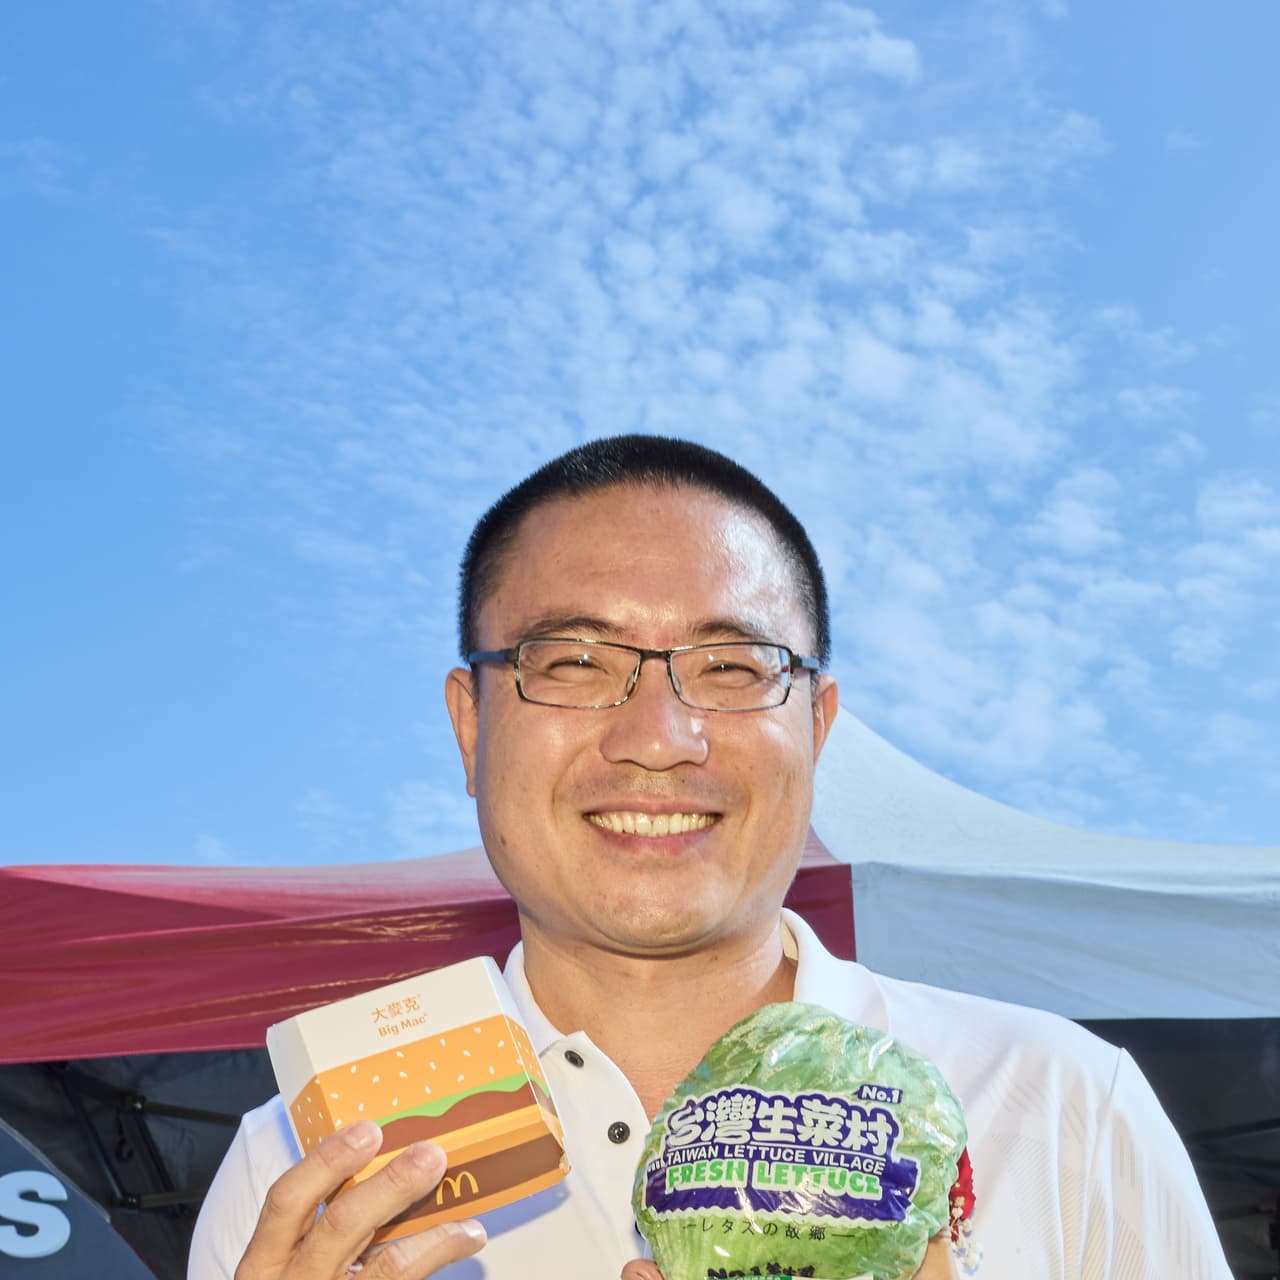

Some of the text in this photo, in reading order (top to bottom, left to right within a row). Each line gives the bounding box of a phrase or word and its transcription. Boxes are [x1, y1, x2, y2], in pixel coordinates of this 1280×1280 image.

[378, 1024, 400, 1037] Big
[861, 1085, 901, 1103] No.1
[668, 1094, 892, 1155] 台灣生菜村
[667, 1145, 887, 1175] TAIWAN LETTUCE VILLAGE
[669, 1160, 881, 1194] FRESH LETTUCE
